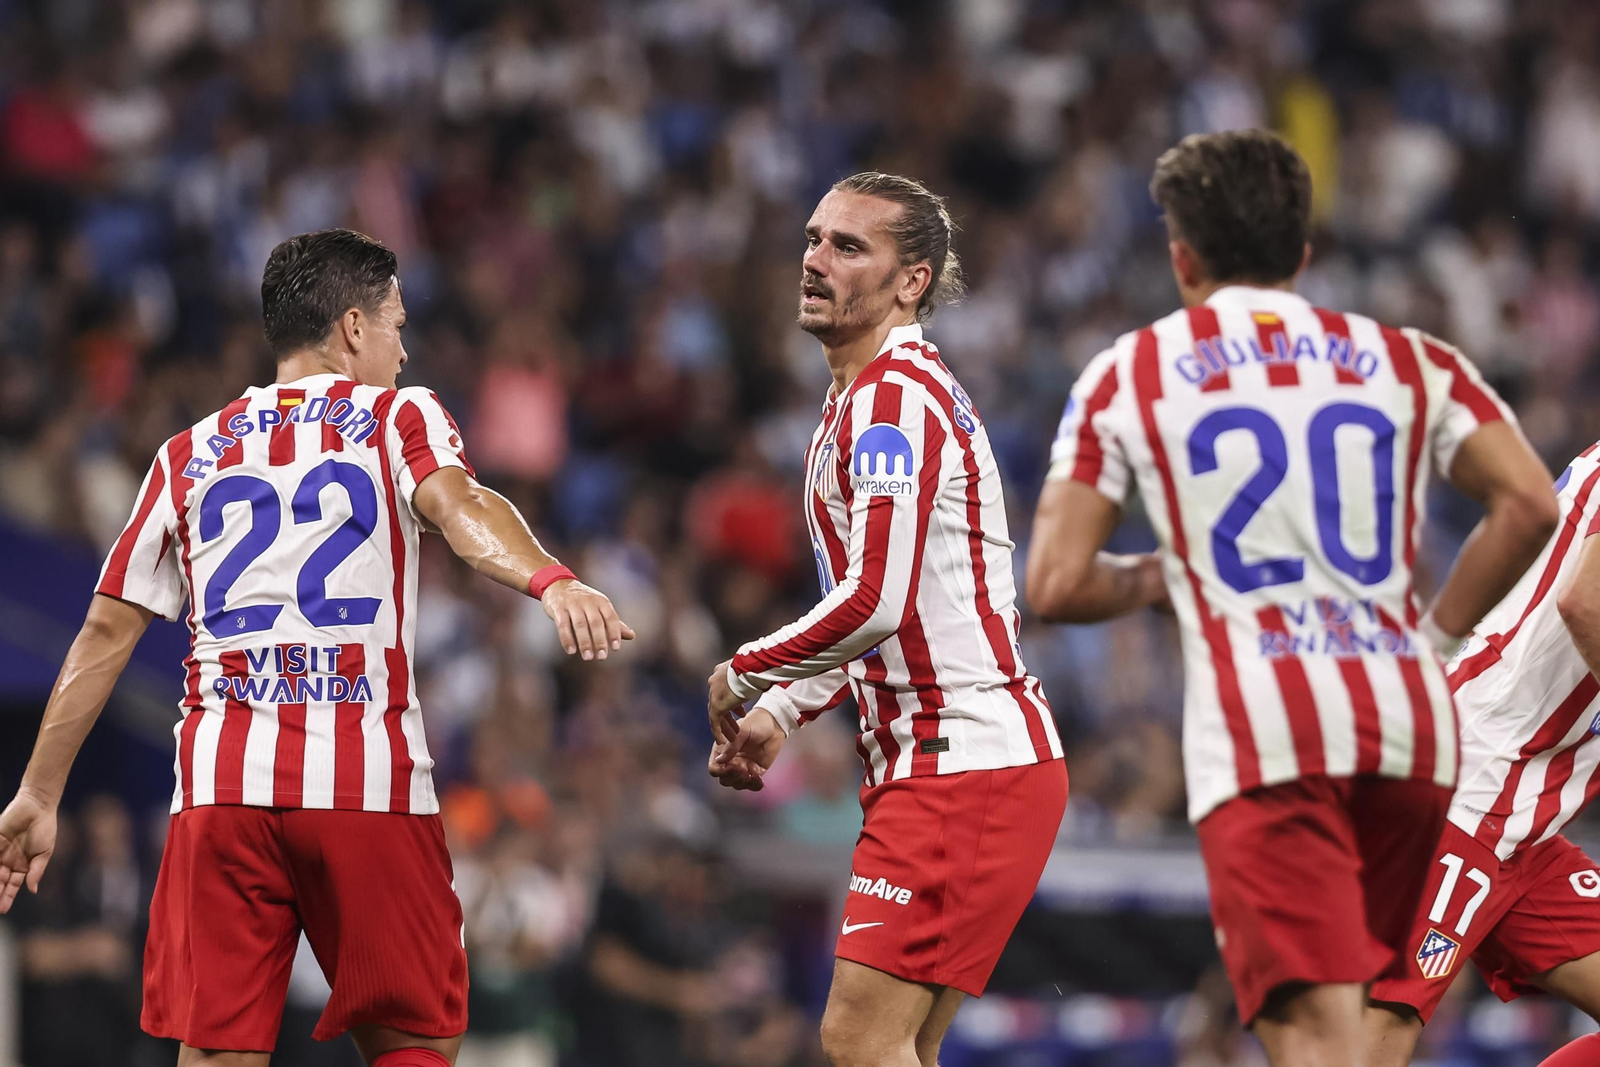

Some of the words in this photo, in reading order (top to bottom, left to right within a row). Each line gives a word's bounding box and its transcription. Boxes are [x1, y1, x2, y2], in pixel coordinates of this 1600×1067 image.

[1174, 332, 1380, 384] GIULIANO
[183, 396, 378, 480] RASPADORI
[857, 479, 912, 495] kraken
[1187, 401, 1395, 594] 20
[200, 459, 383, 640] 22
[212, 675, 374, 703] RWANDA
[244, 645, 342, 673] VISIT
[1428, 852, 1491, 937] 17
